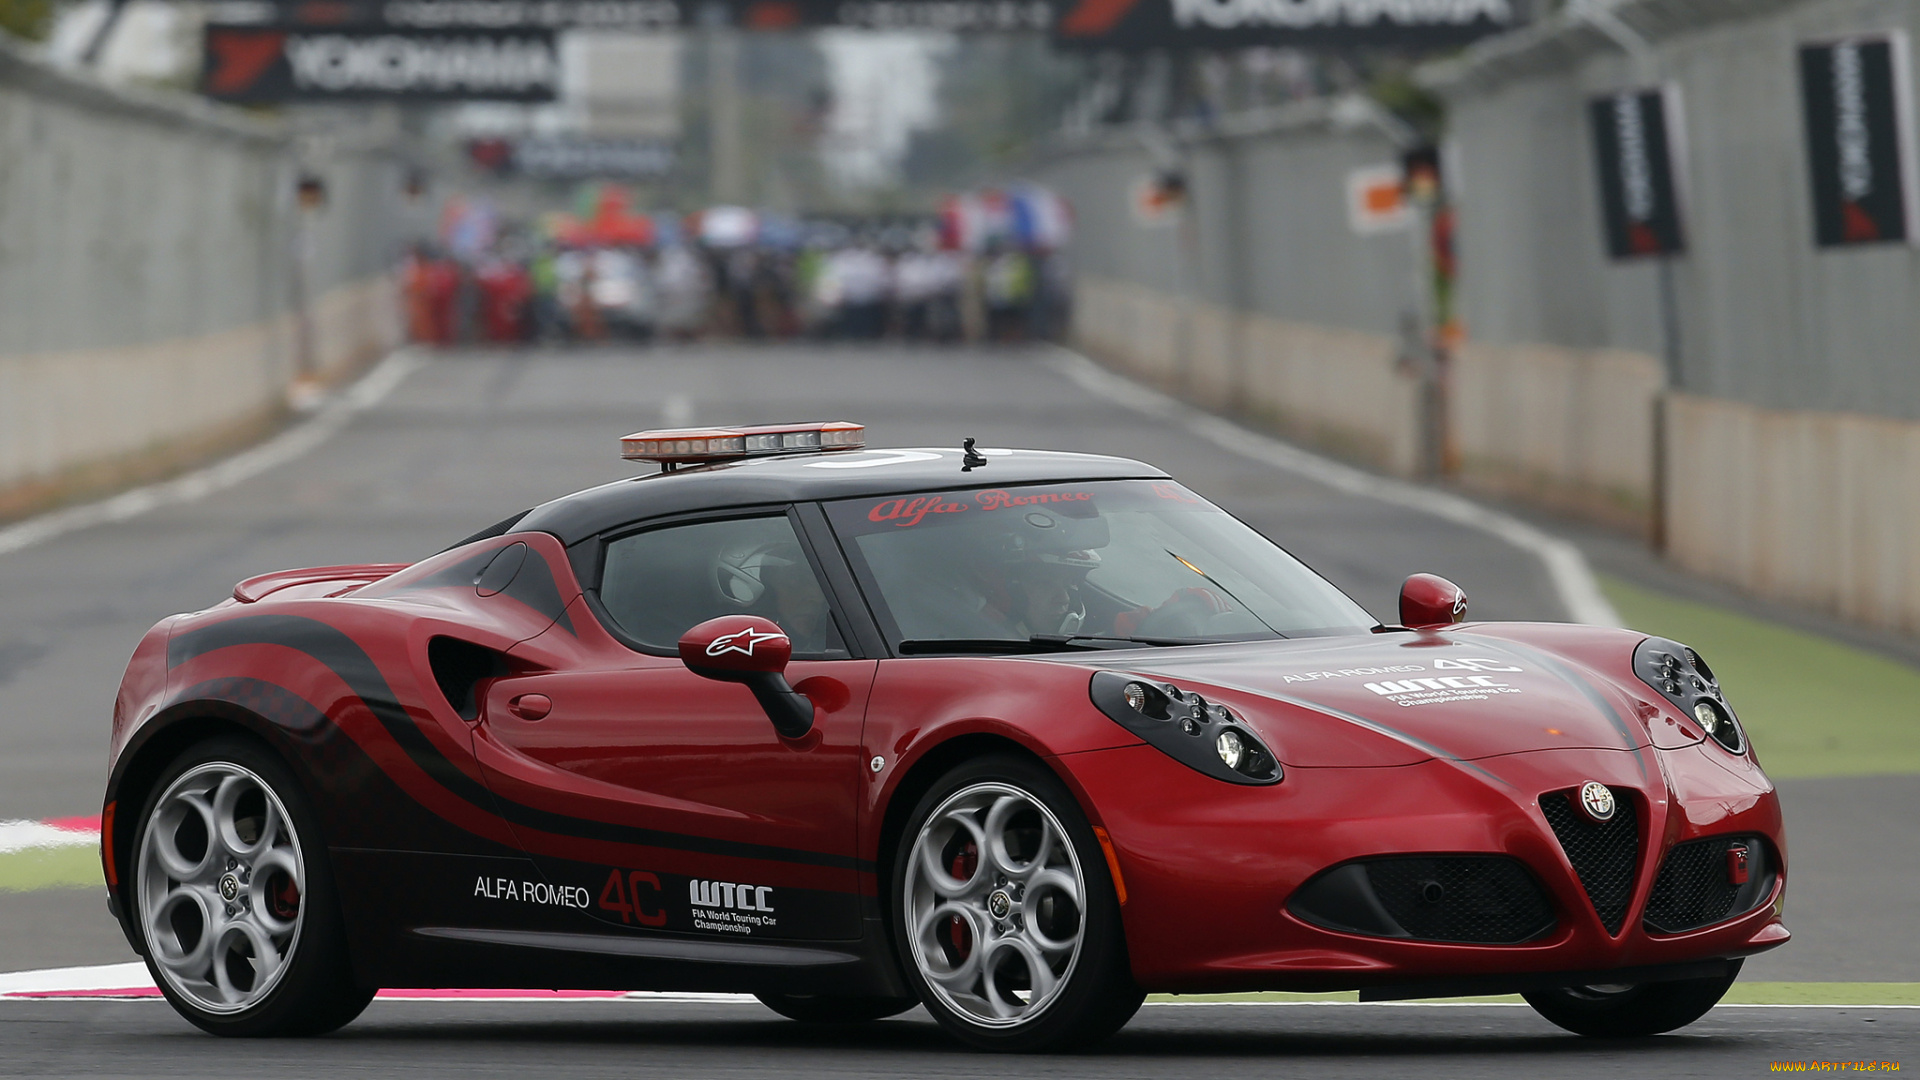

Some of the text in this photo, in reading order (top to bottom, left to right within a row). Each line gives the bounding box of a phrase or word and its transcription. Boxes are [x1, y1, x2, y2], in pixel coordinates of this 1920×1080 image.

[867, 489, 1095, 527] Alfa Romeo
[1282, 657, 1524, 684] ALFA ROMEO 4C
[1363, 675, 1510, 696] WTCC
[1386, 686, 1523, 702] FIA World Touring Car
[1397, 694, 1489, 707] Championship
[474, 868, 668, 927] ALFA ROMEO 4C
[689, 879, 775, 912] WTCC
[692, 908, 777, 926] FIA World Touring Car
[694, 919, 751, 935] Championship
